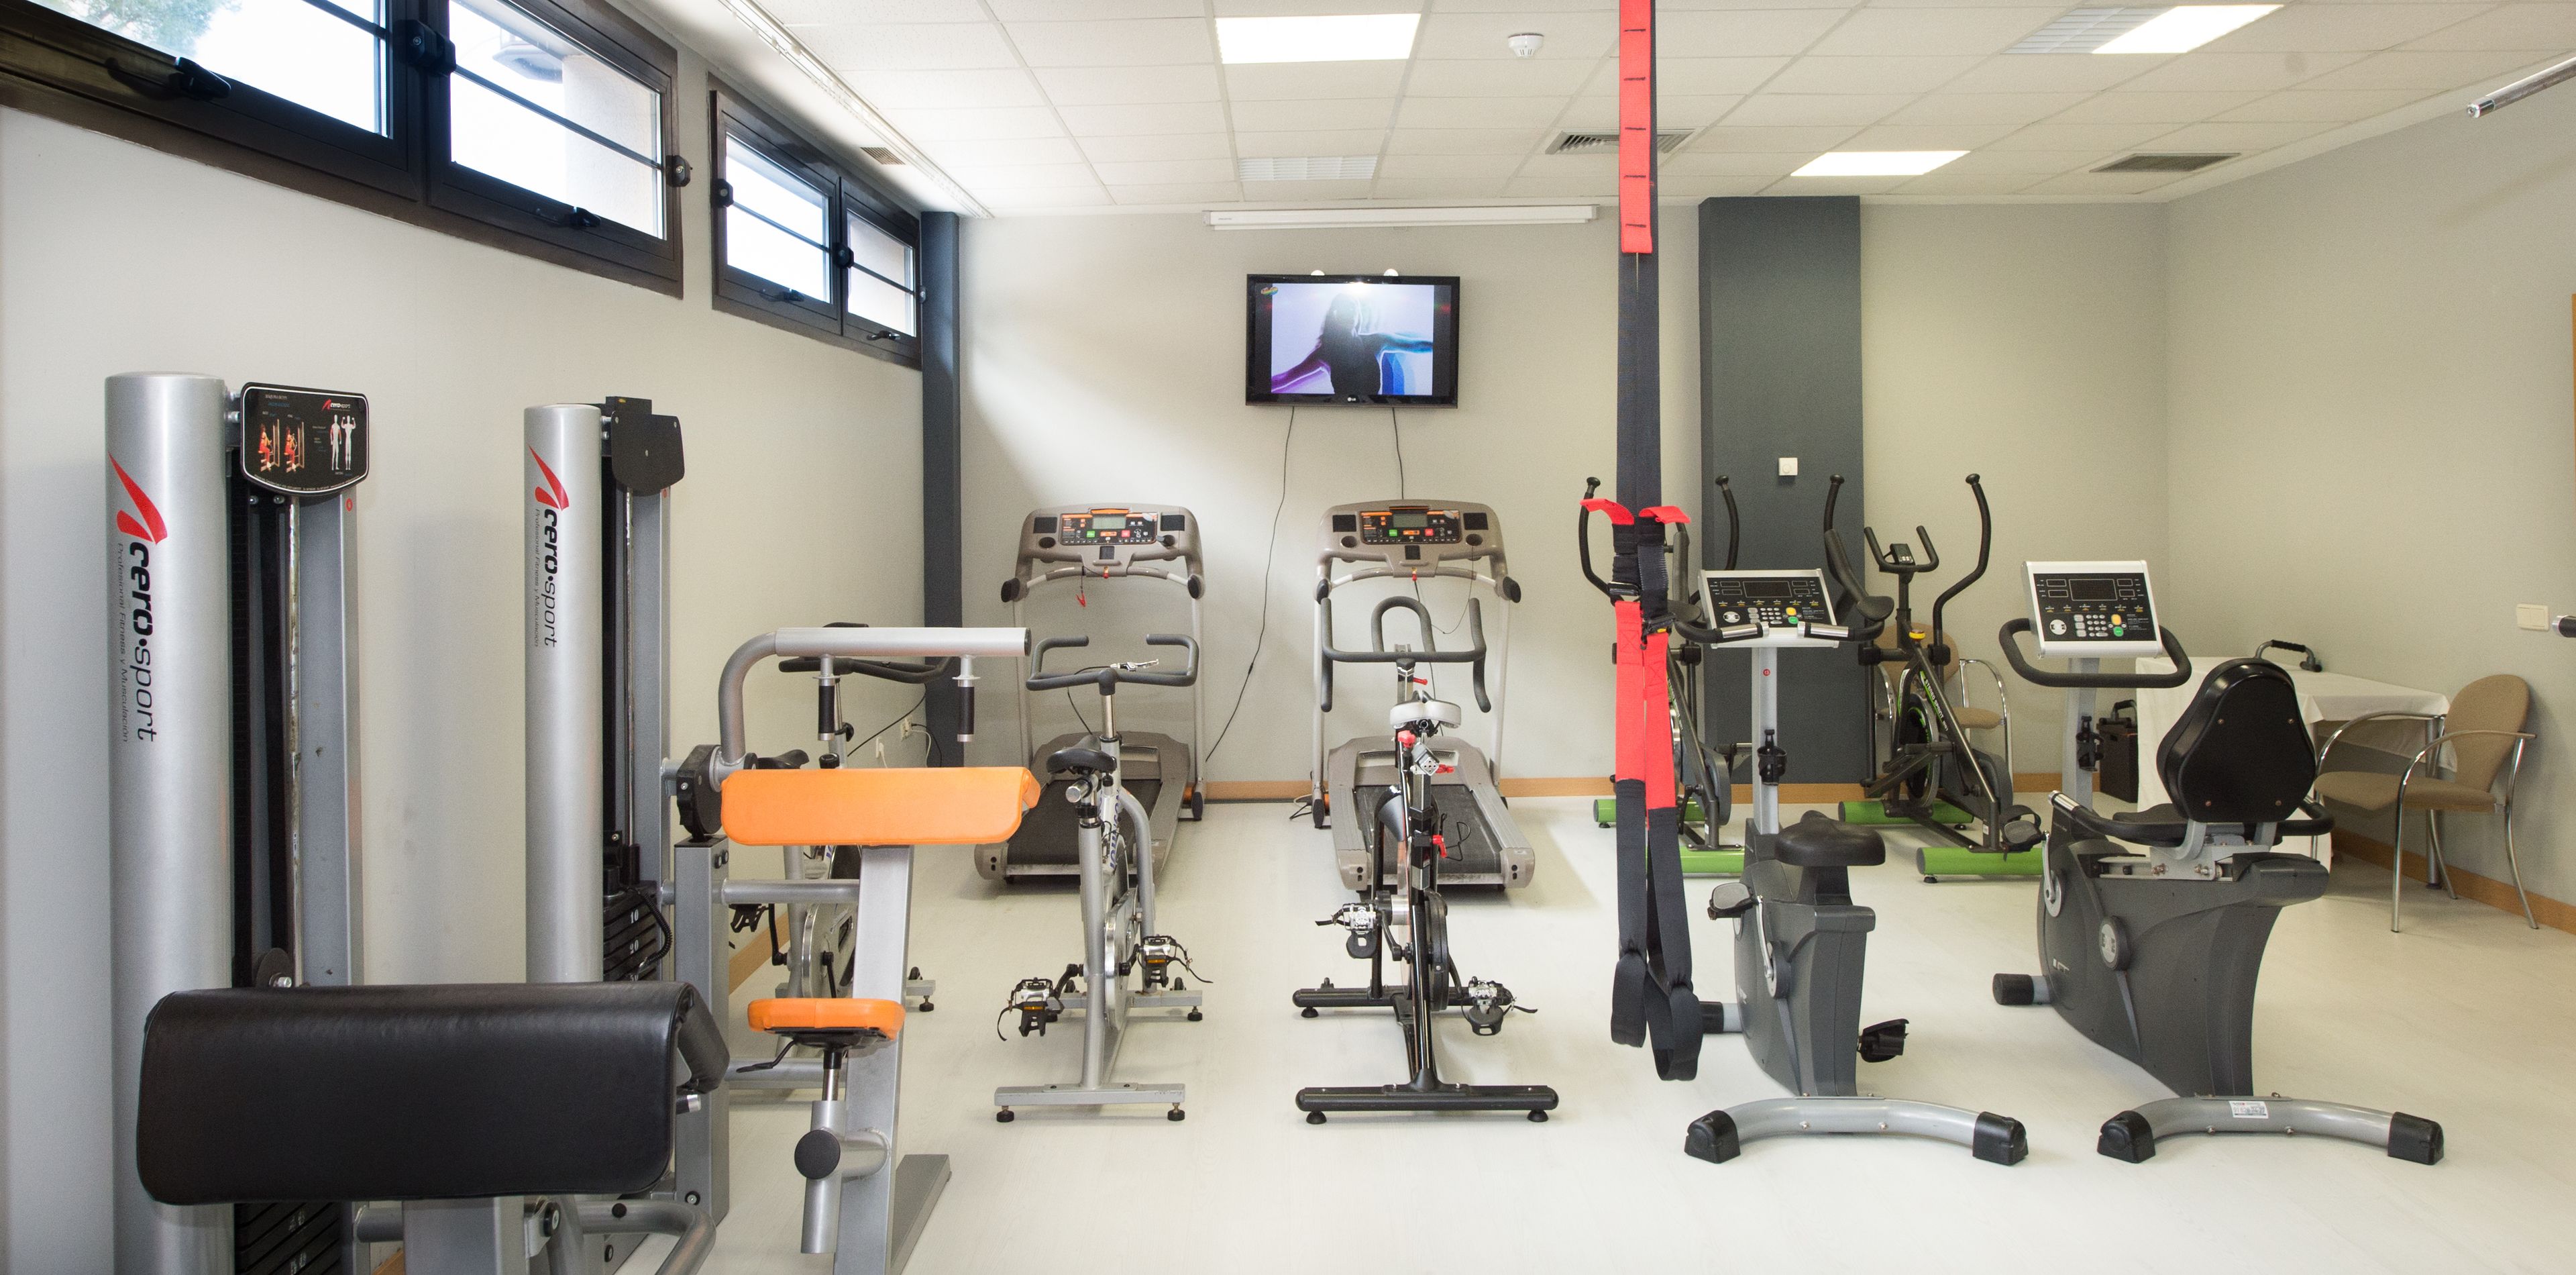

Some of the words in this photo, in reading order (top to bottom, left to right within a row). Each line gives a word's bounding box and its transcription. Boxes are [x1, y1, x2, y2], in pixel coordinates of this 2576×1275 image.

[118, 611, 127, 655] Fitness
[119, 658, 126, 666] y
[630, 909, 639, 923] 10
